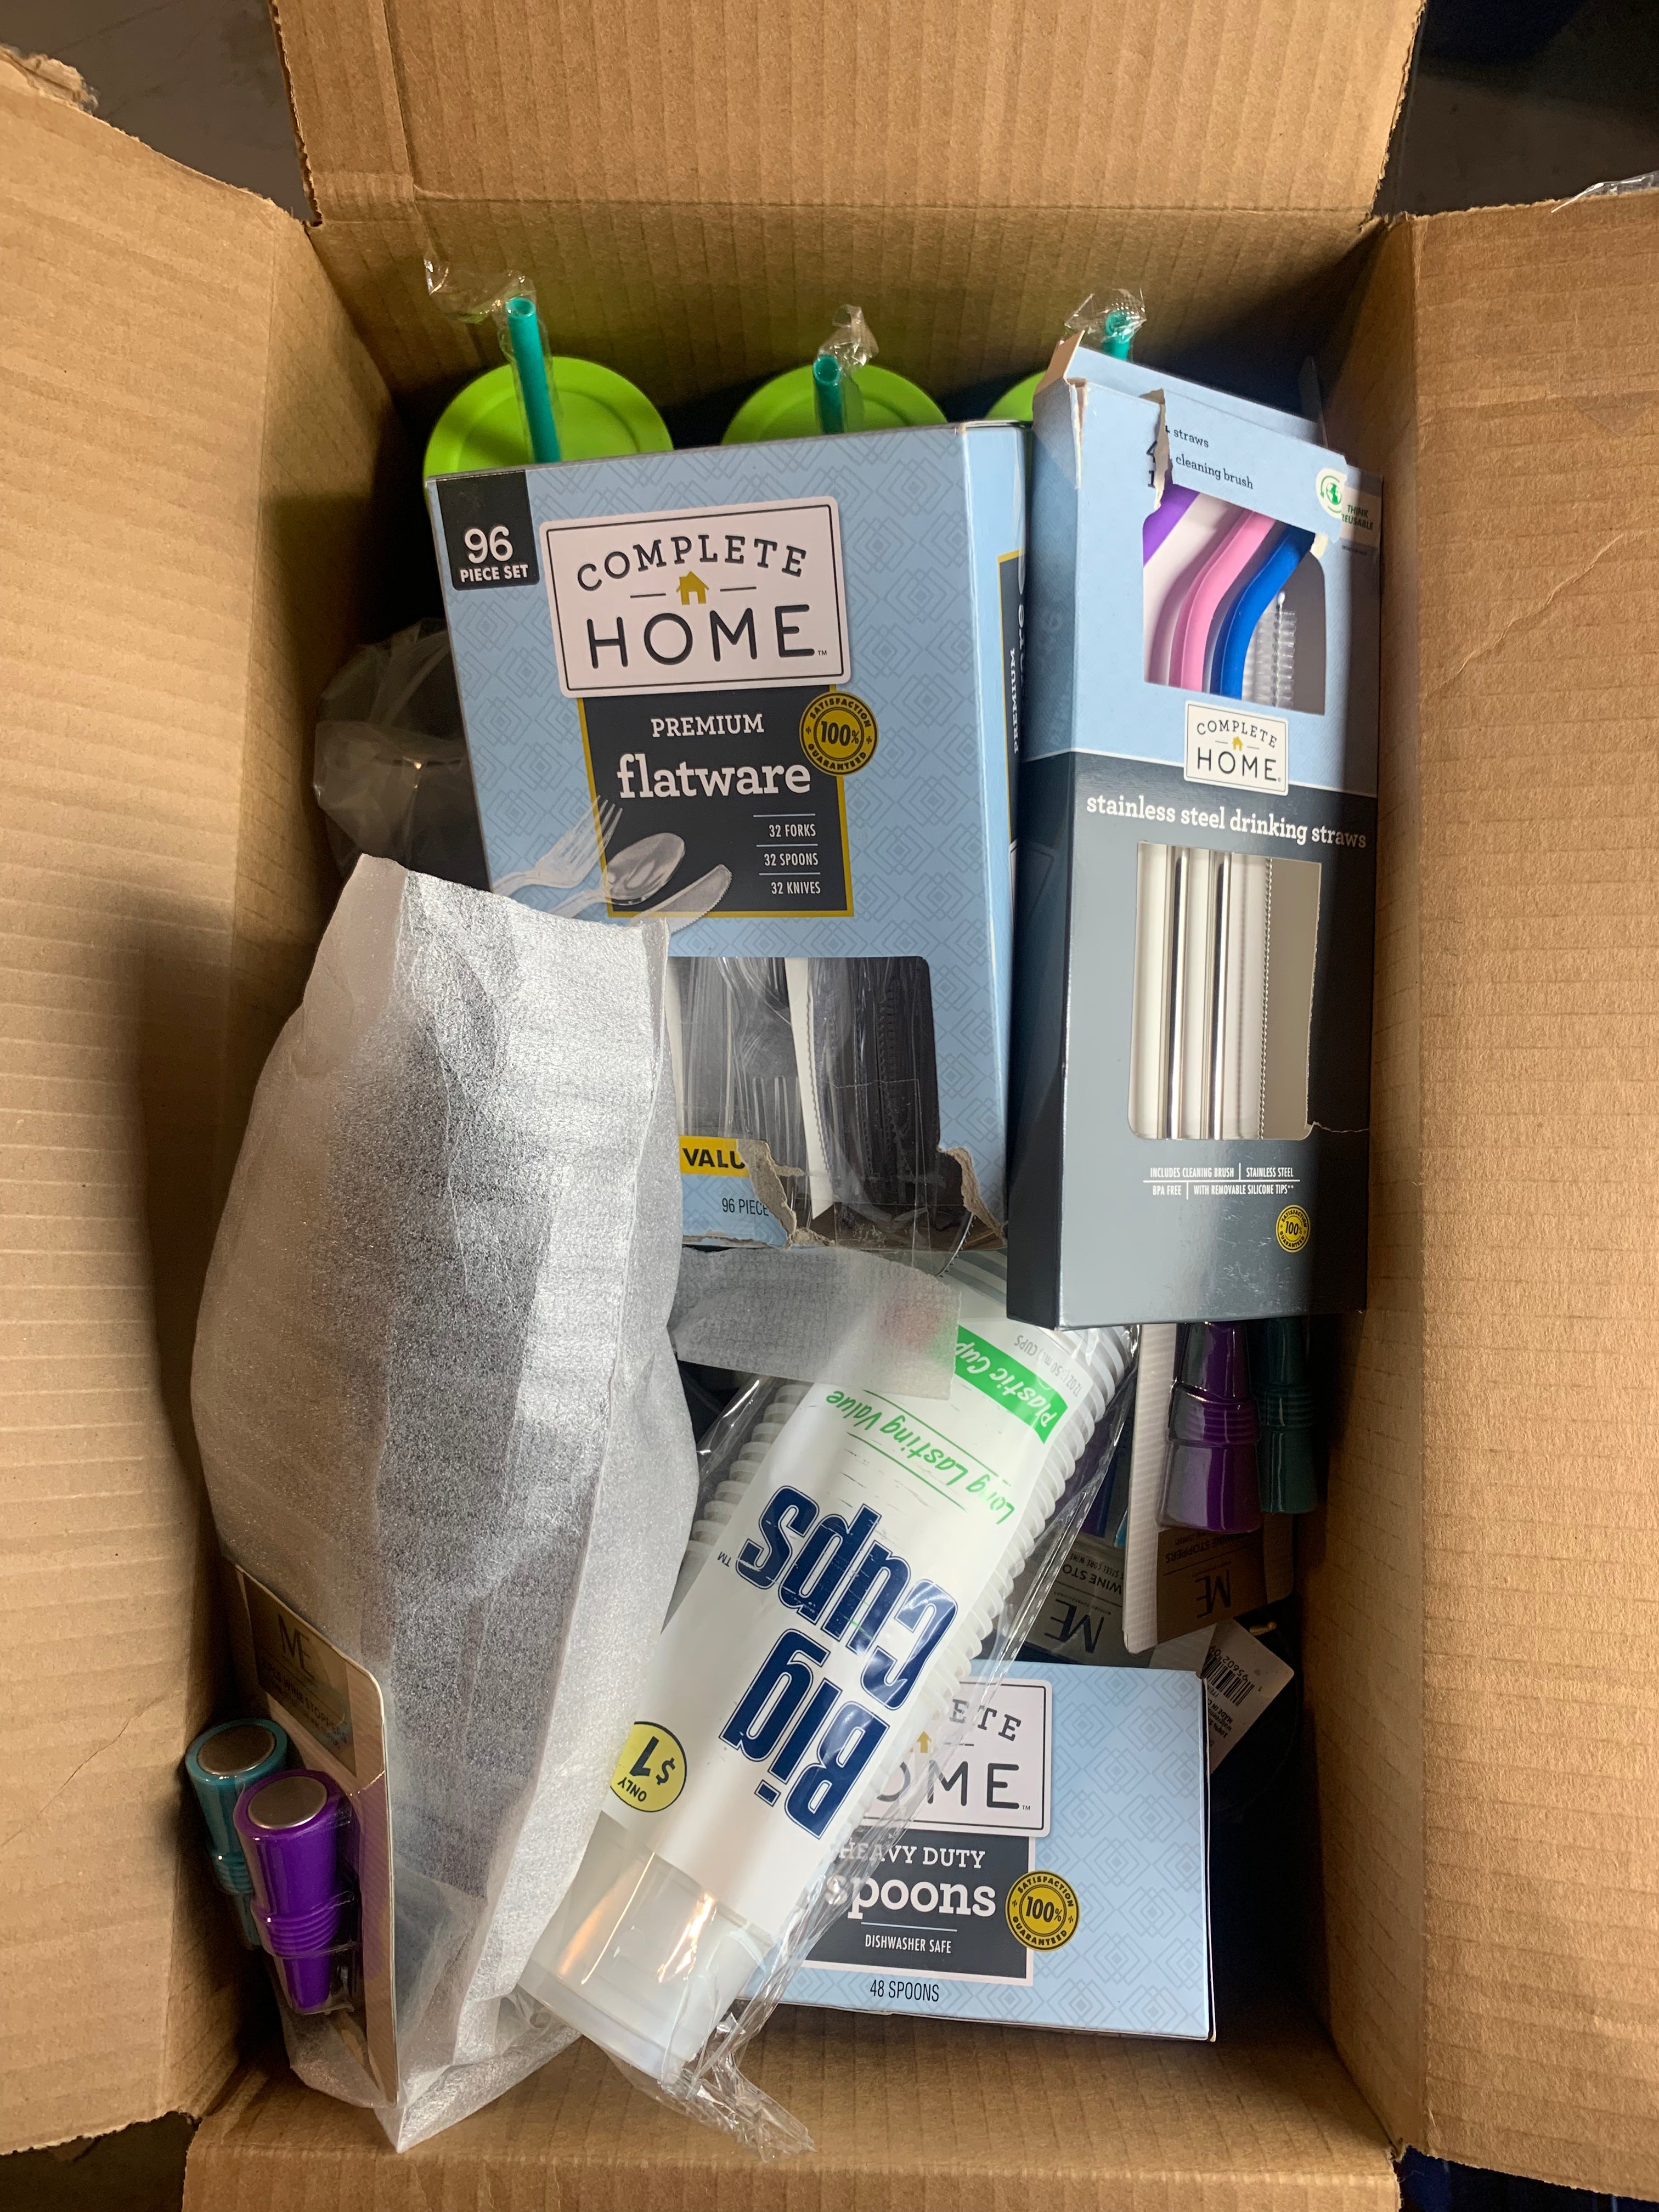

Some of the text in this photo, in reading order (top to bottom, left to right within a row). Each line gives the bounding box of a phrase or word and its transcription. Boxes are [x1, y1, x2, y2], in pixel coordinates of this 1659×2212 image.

[1173, 430, 1209, 448] straws
[1176, 454, 1221, 480] cleaning
[1223, 469, 1254, 489] brush
[1347, 504, 1368, 518] THINK
[465, 526, 513, 563] 96
[460, 565, 528, 582] PIECE SET
[577, 534, 806, 591] COMPLETE
[587, 605, 815, 669] HOME
[810, 698, 871, 727] SATISFACTION
[1010, 648, 1019, 754] PREMIUM
[651, 714, 765, 738] PREMIUM
[821, 721, 860, 746] 100%
[1197, 720, 1277, 748] COMPLETE
[808, 743, 866, 770] GUARANTEED
[1197, 747, 1277, 781] HOME
[617, 753, 811, 798] flatware
[769, 823, 816, 837] 32 FORKS
[1086, 795, 1367, 848] stainless steel drinking straws
[764, 853, 819, 866] 32 SPOONS
[771, 881, 821, 894] 32 KNIVES
[1150, 1167, 1234, 1178] INCLUDES CLEANING BRUSH
[1246, 1167, 1294, 1177] STAINLESS STEEL
[1153, 1185, 1182, 1195] BPA FREE
[1193, 1185, 1209, 1195] WITH
[1211, 1184, 1246, 1195] REMOVABLE
[1248, 1184, 1274, 1194] SILICONE
[722, 1198, 769, 1216] 96 PIECE
[1281, 1209, 1307, 1228] SATISFACTION
[1280, 1231, 1305, 1248] GUARANTEED
[1285, 1221, 1302, 1235] 100%
[1014, 1335, 1037, 1356] CUPS
[990, 1368, 1057, 1427] Plastic
[826, 1391, 882, 1431] Value
[879, 1415, 968, 1486] Lasting
[1165, 1540, 1210, 1564] STOPPERS
[1088, 1573, 1122, 1594] WINE
[1194, 1569, 1231, 1618] ME
[735, 1485, 958, 1710] Cups
[1044, 1599, 1104, 1654] ME
[1223, 1656, 1249, 1681] 95602
[1211, 1703, 1220, 1711] IN
[1217, 1708, 1233, 1724] MADE
[719, 1628, 890, 1839] Big
[629, 1736, 675, 1786] $1
[617, 1777, 647, 1802] ONLY
[876, 1760, 1019, 1809] OME
[838, 1839, 986, 1869] HEAVY DUTY
[826, 1875, 996, 1920] spoons
[1018, 1876, 1074, 1907] SATISFACTION
[1026, 1896, 1063, 1922] 100%
[1013, 1916, 1066, 1945] GUARANTEED
[865, 1934, 952, 1954] DISHWASHER SAFE
[870, 1979, 939, 2002] 48 SPOONS
